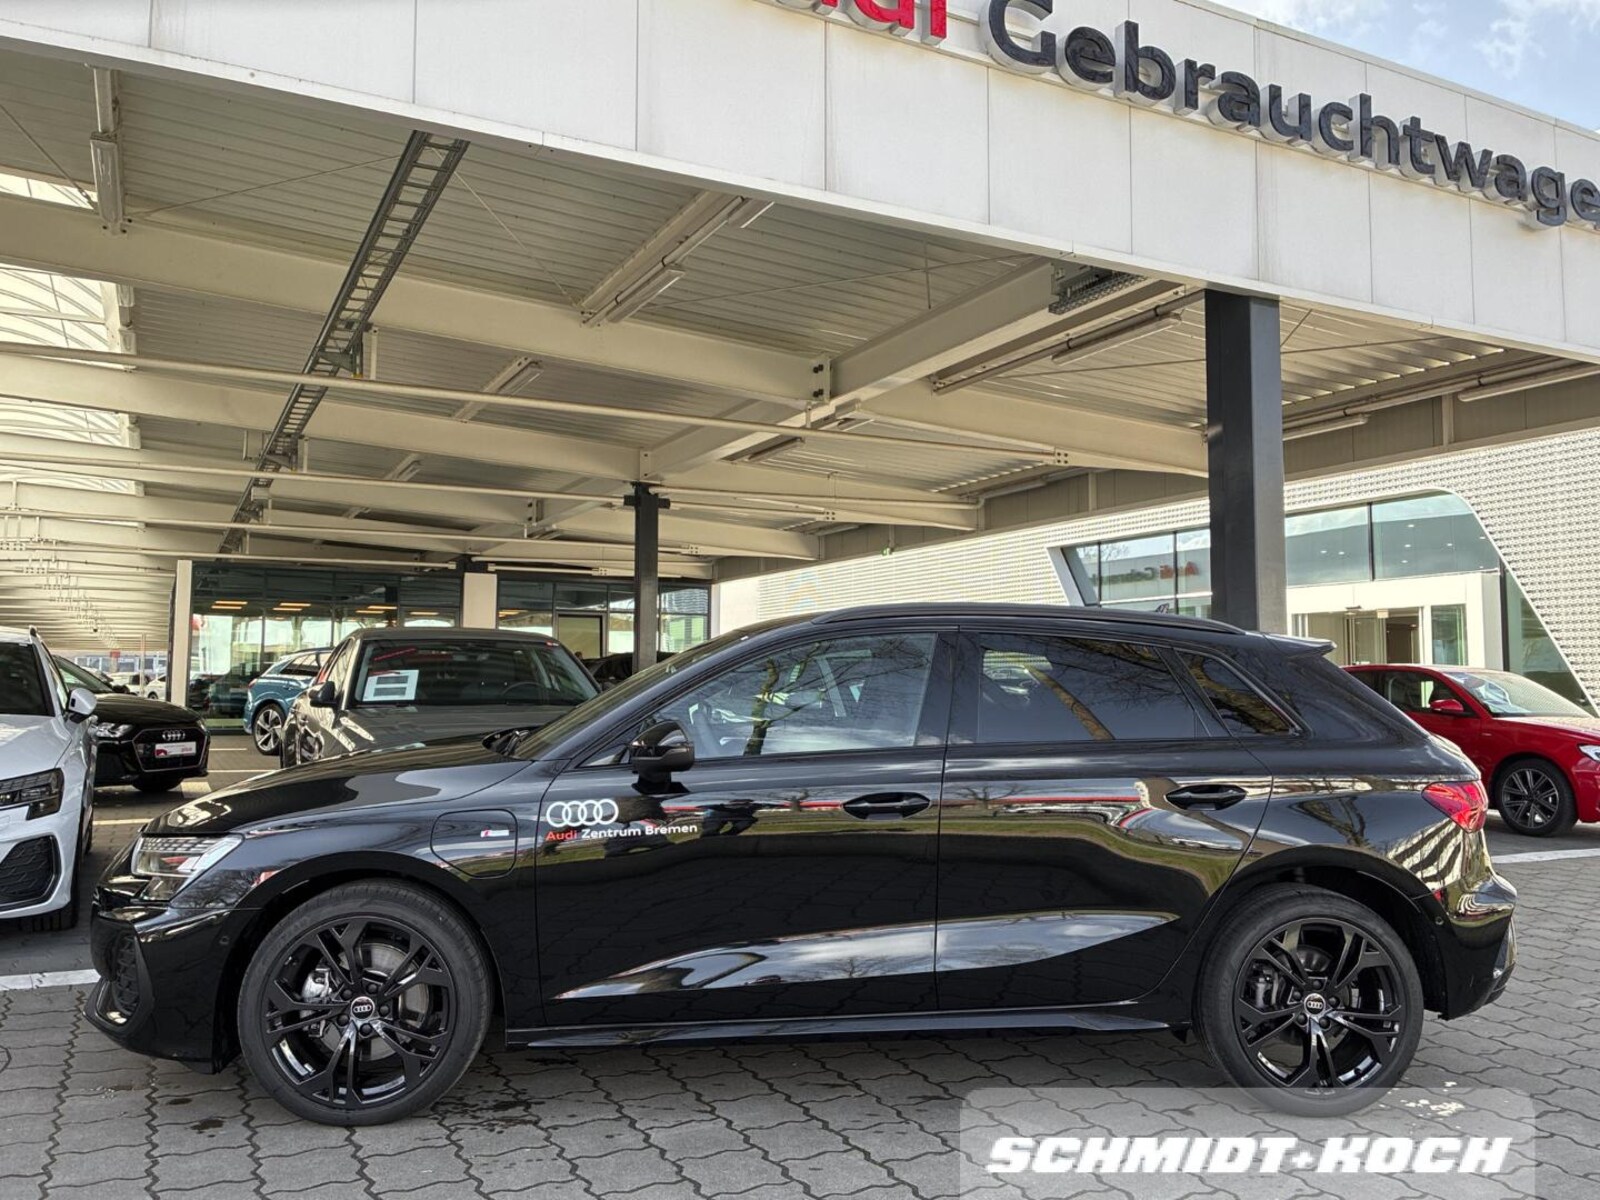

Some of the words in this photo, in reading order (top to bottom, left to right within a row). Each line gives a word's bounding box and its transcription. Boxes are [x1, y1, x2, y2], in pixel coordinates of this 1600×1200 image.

[545, 829, 578, 841] Audi
[581, 827, 642, 840] Zentrum
[644, 824, 699, 836] Bremen
